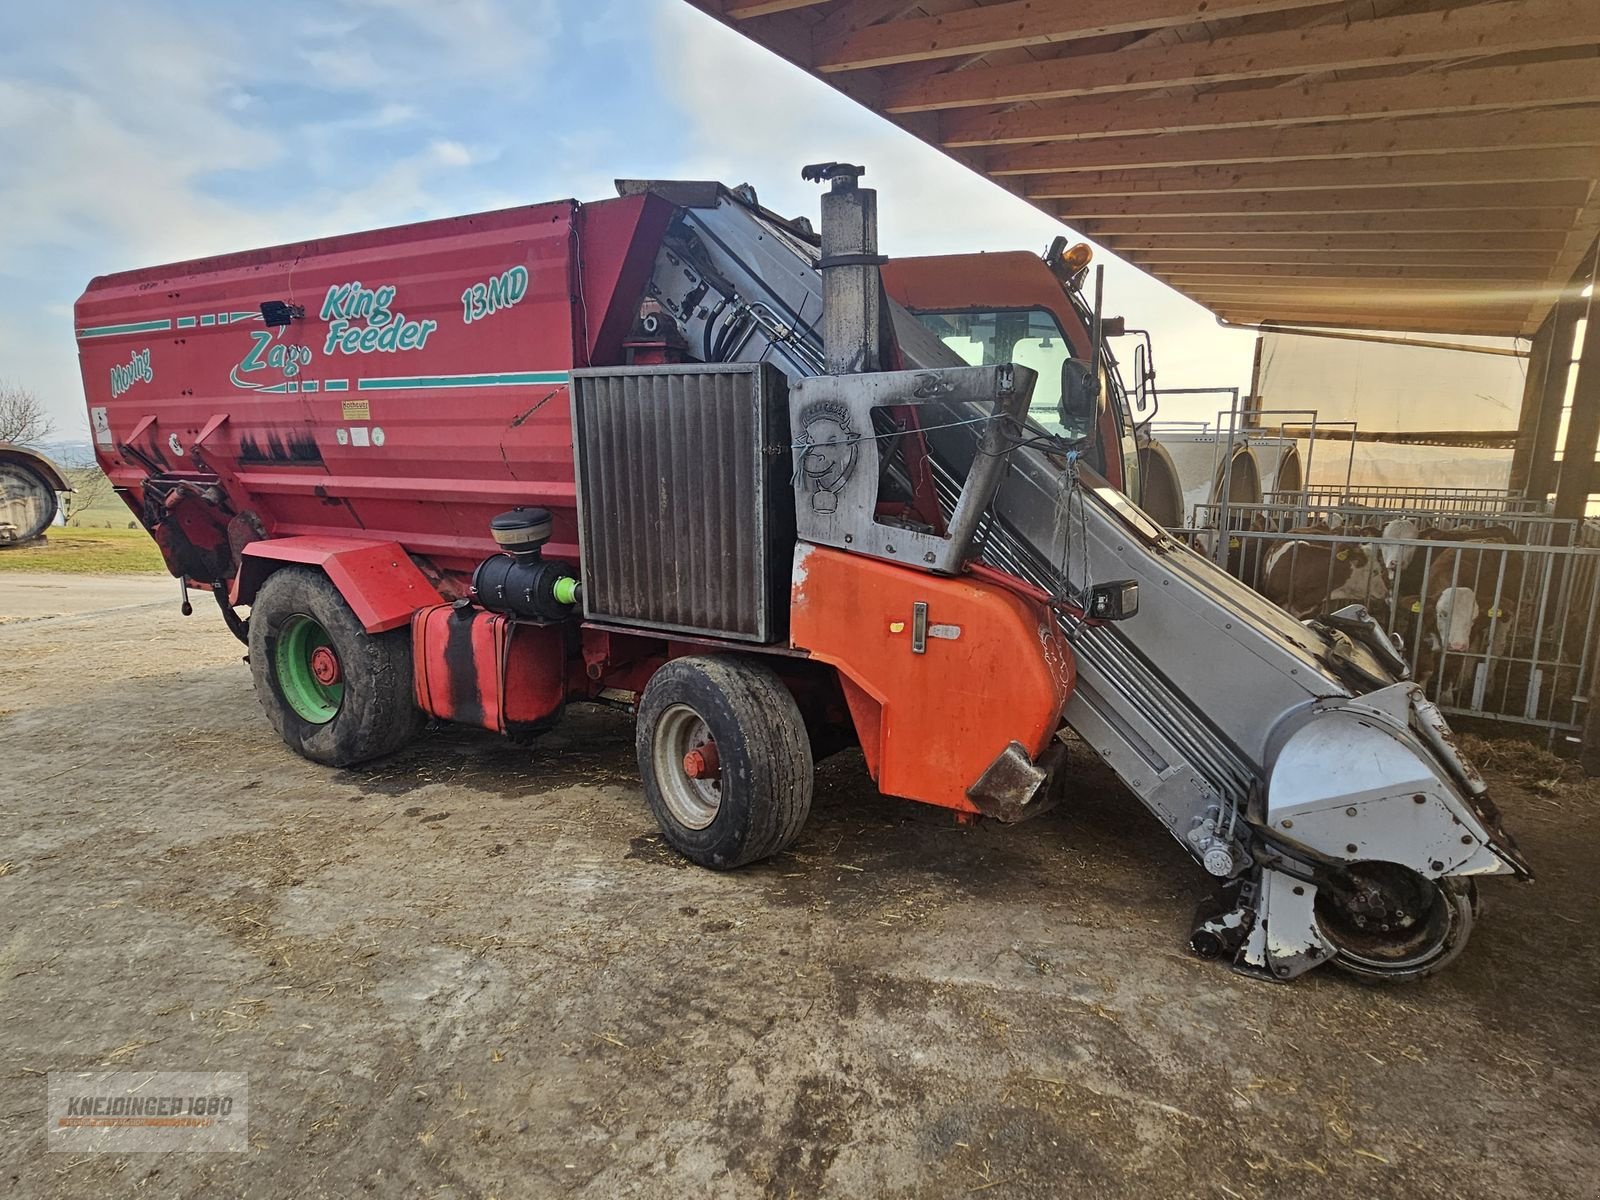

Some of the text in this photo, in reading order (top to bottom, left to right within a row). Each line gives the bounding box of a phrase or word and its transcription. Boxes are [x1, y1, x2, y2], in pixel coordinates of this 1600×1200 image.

[320, 281, 396, 327] King
[461, 265, 528, 324] 13MD
[240, 330, 312, 377] Zago
[323, 312, 438, 355] Feeder
[110, 348, 153, 398] Moving
